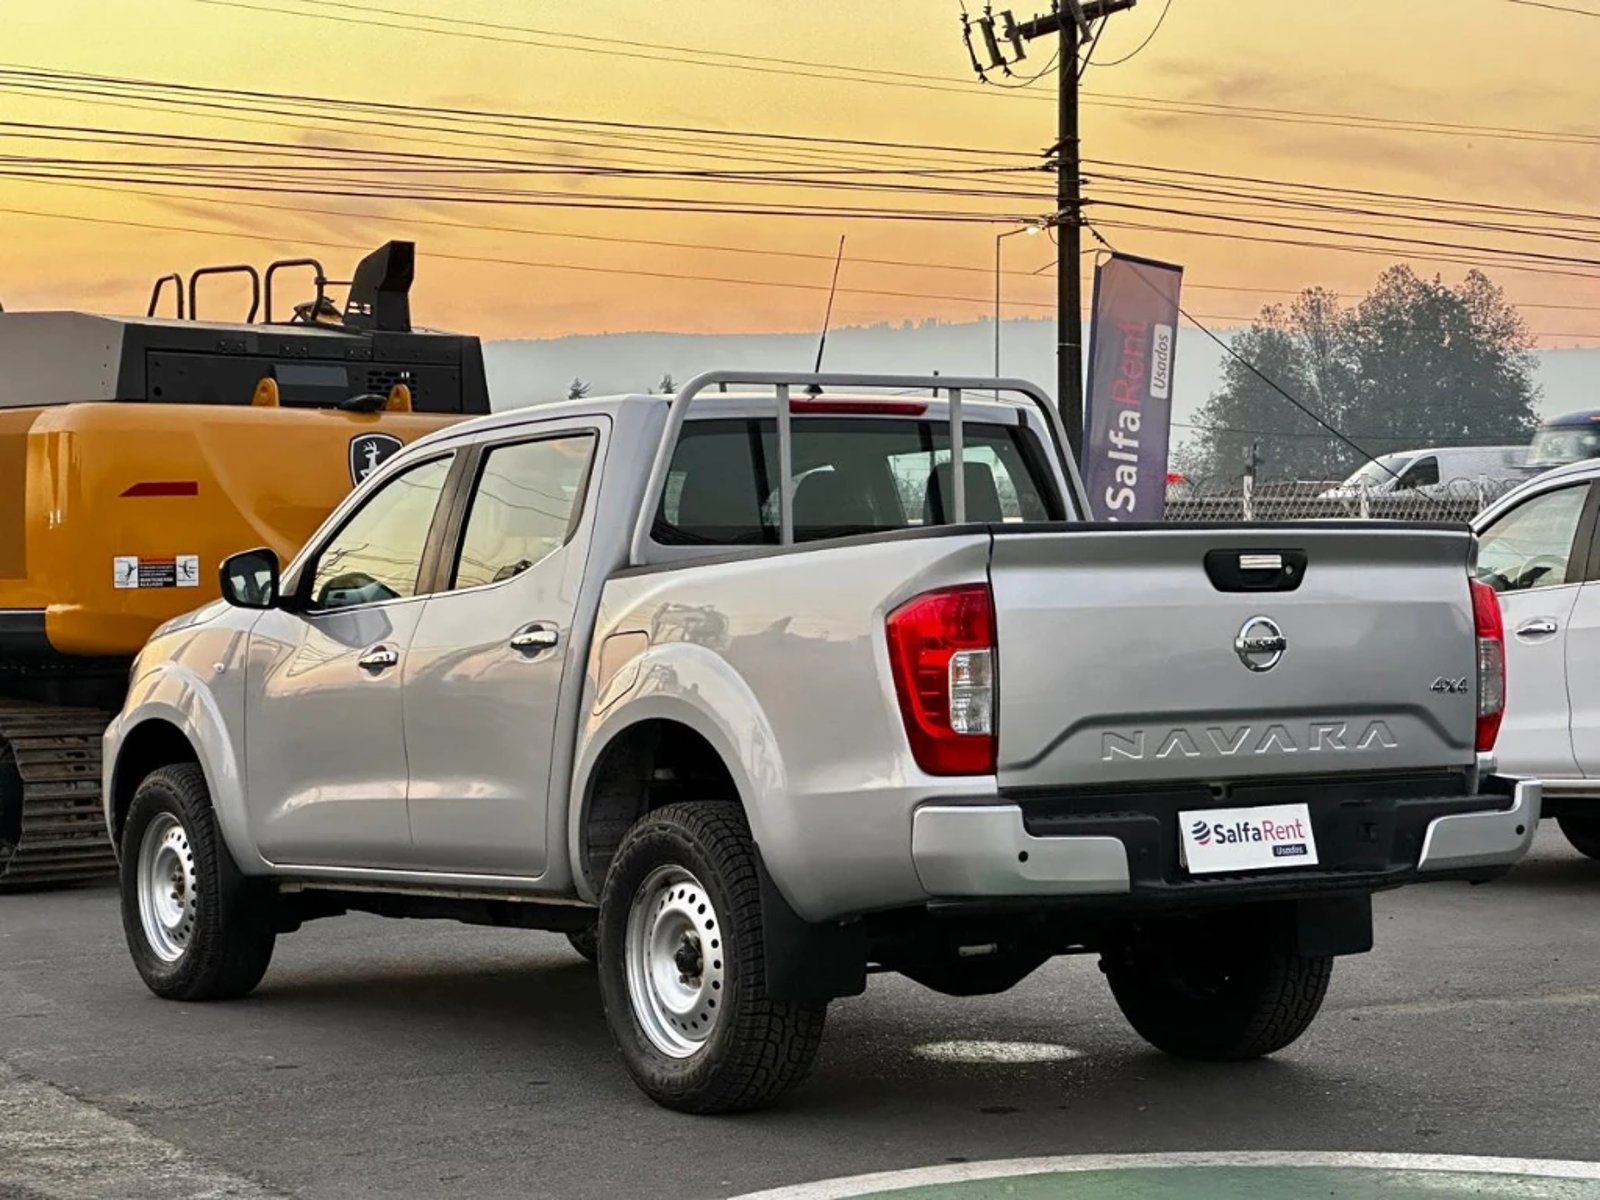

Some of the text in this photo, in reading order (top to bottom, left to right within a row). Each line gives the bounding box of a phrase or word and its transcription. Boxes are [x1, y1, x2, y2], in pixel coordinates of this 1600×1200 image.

[1153, 333, 1170, 390] Usados
[1105, 321, 1148, 513] SalfaRent
[1101, 720, 1399, 761] NAVARA
[1213, 818, 1305, 845] SalfaRent
